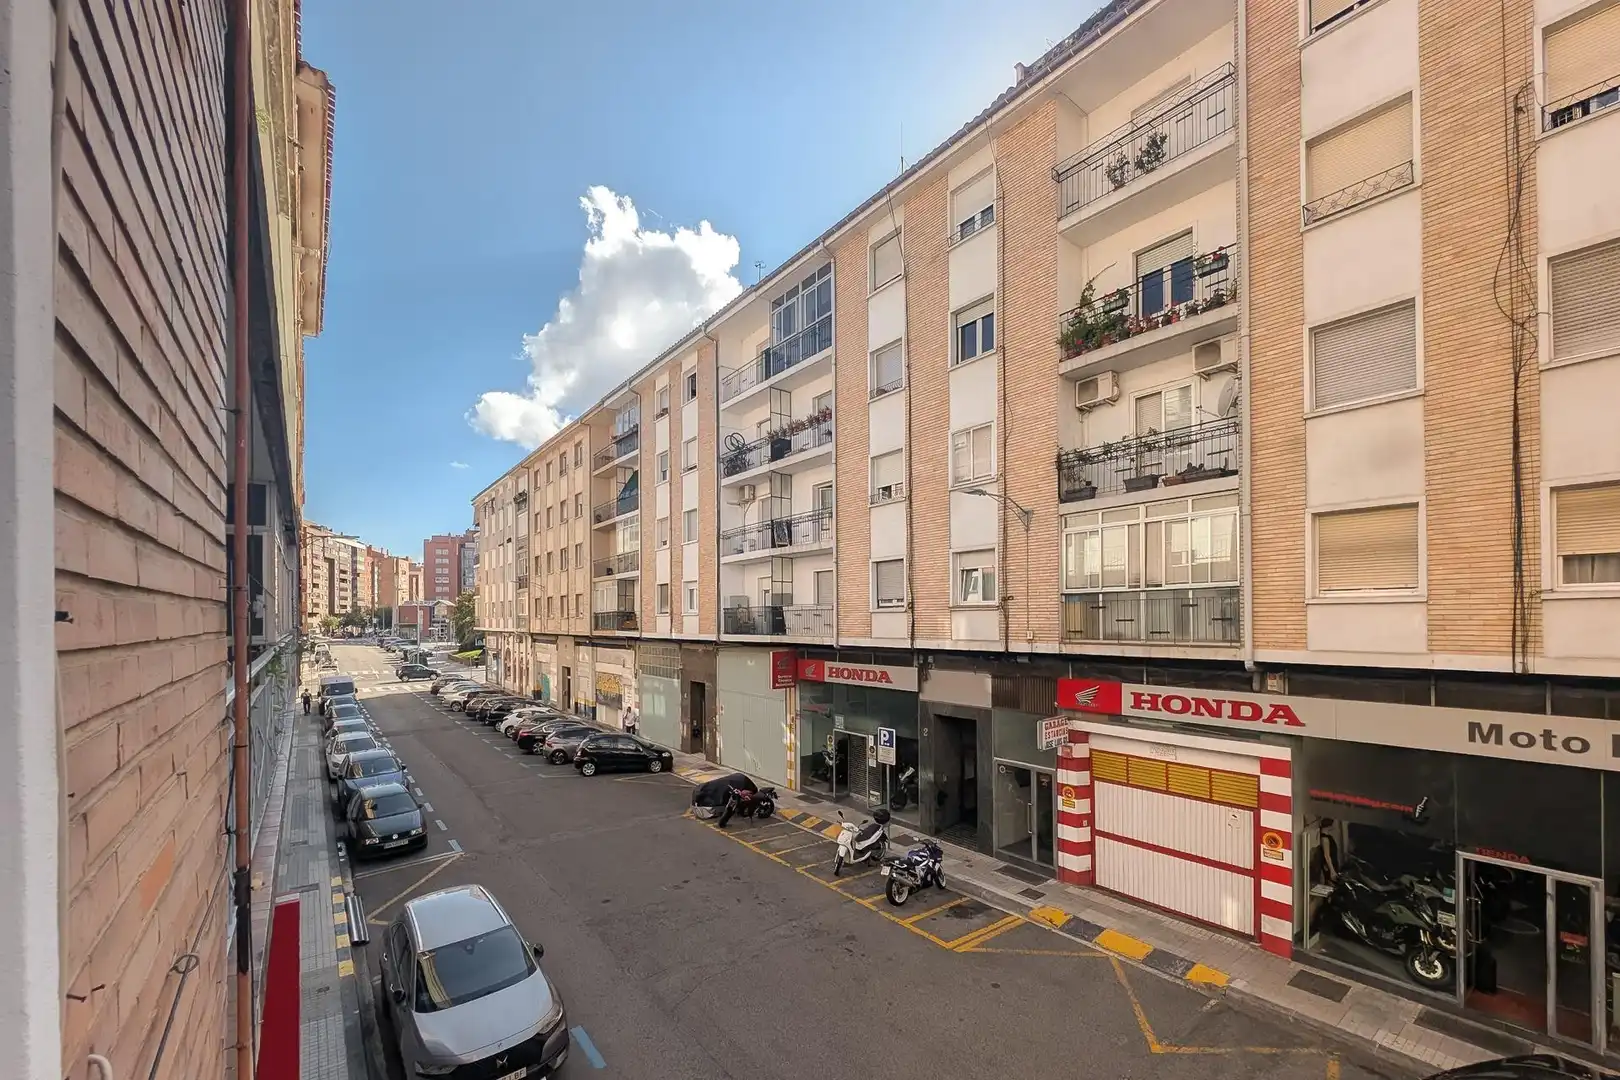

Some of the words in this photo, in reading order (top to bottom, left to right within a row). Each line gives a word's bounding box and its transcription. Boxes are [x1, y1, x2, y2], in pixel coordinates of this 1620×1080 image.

[828, 666, 893, 683] HONDA
[1130, 691, 1306, 727] HONDA
[923, 727, 929, 737] 2
[1044, 718, 1068, 730] GARAGE
[880, 729, 890, 746] P
[1468, 721, 1591, 754] Moto
